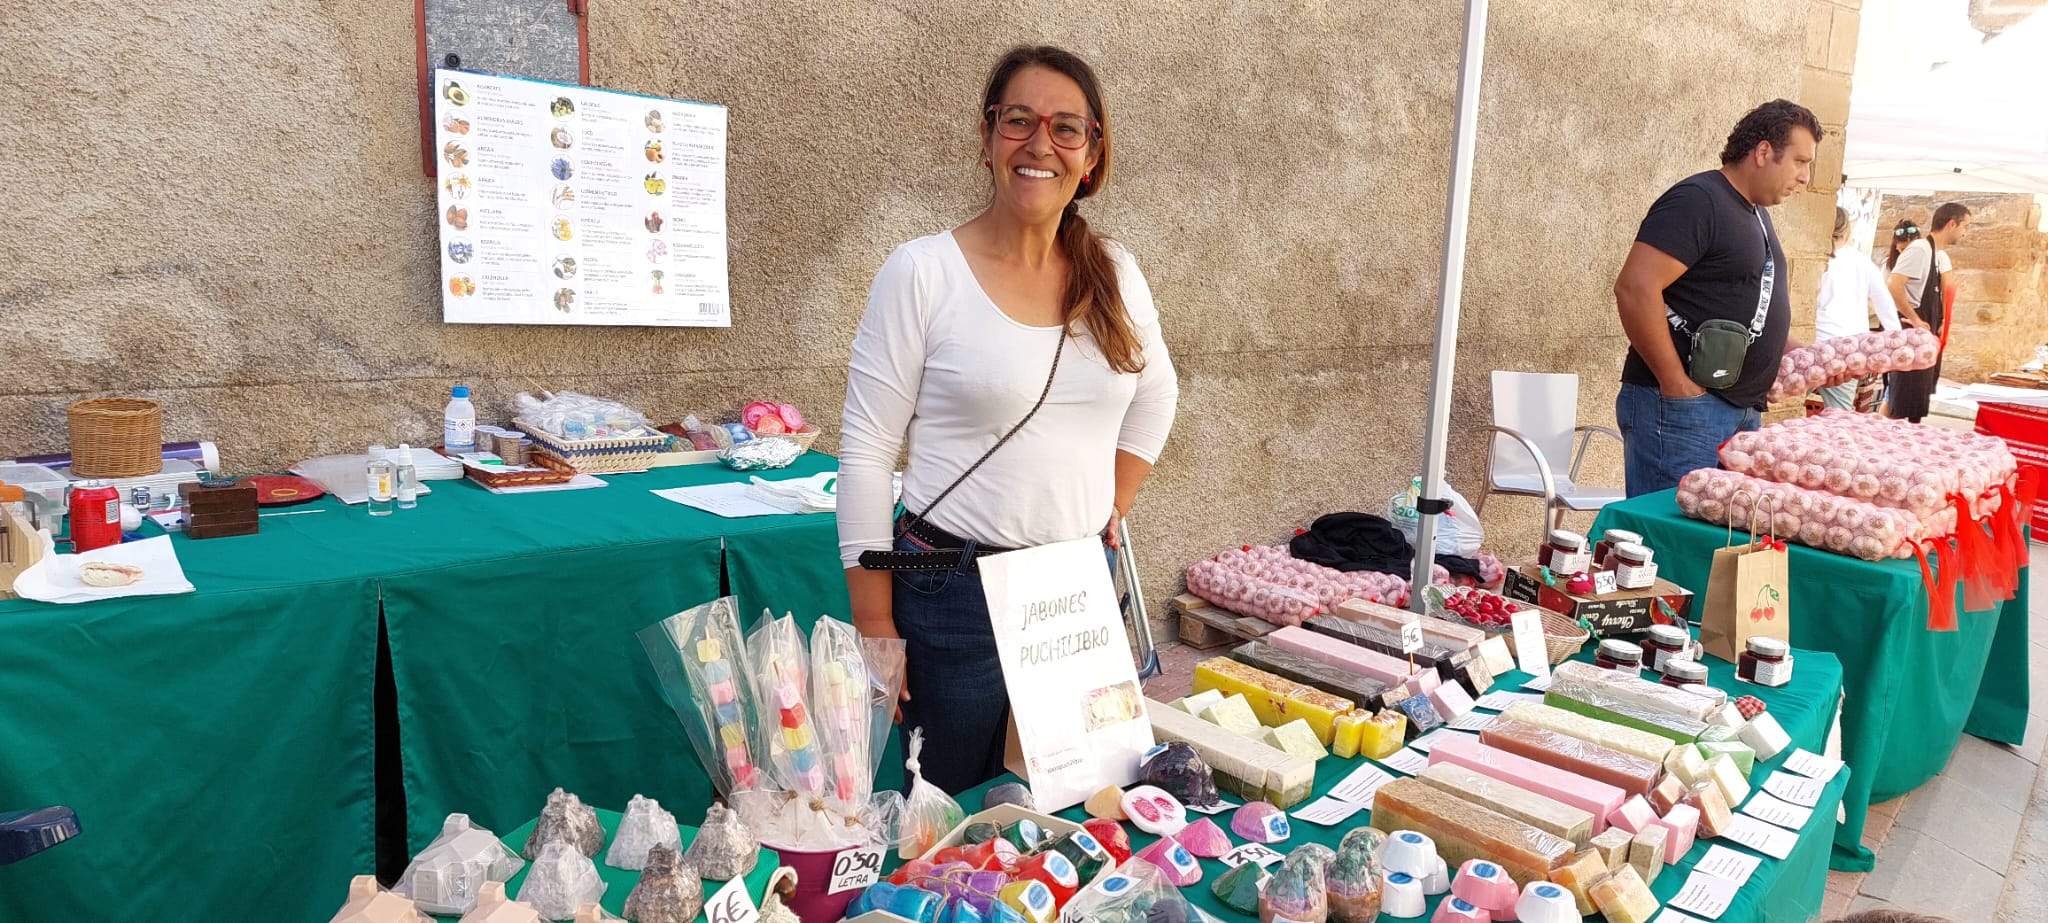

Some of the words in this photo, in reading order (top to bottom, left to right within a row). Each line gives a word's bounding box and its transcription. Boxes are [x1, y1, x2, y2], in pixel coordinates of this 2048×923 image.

[1021, 590, 1087, 631] JABONES
[1601, 615, 1634, 629] Cherry
[1020, 625, 1109, 668] PUCHILIBRO
[1403, 627, 1420, 647] 5€
[838, 874, 868, 888] LETRA
[712, 890, 750, 923] 6€
